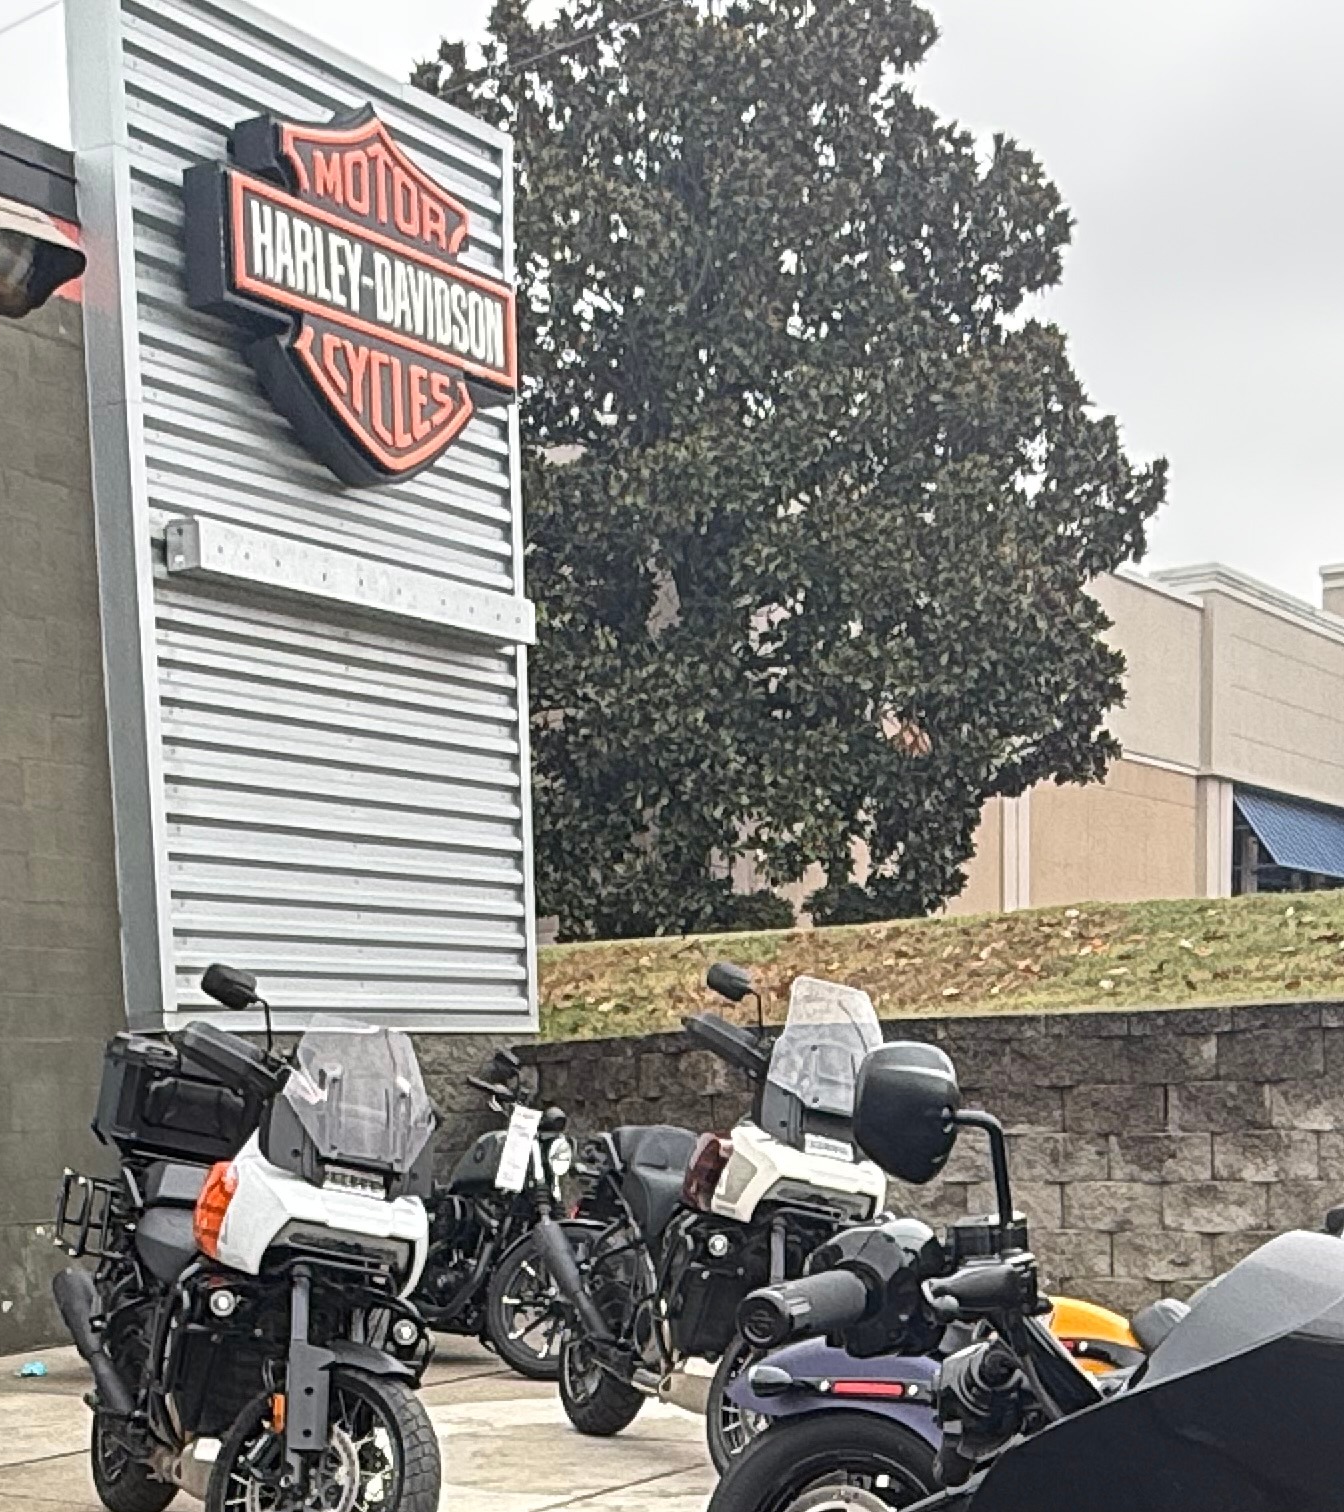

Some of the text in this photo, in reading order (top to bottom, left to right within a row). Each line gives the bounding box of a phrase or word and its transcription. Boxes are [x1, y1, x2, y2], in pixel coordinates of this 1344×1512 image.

[313, 142, 446, 250] MOTOR
[250, 198, 505, 368] HARLEY-DAVIDSON
[321, 333, 455, 448] CYCLES
